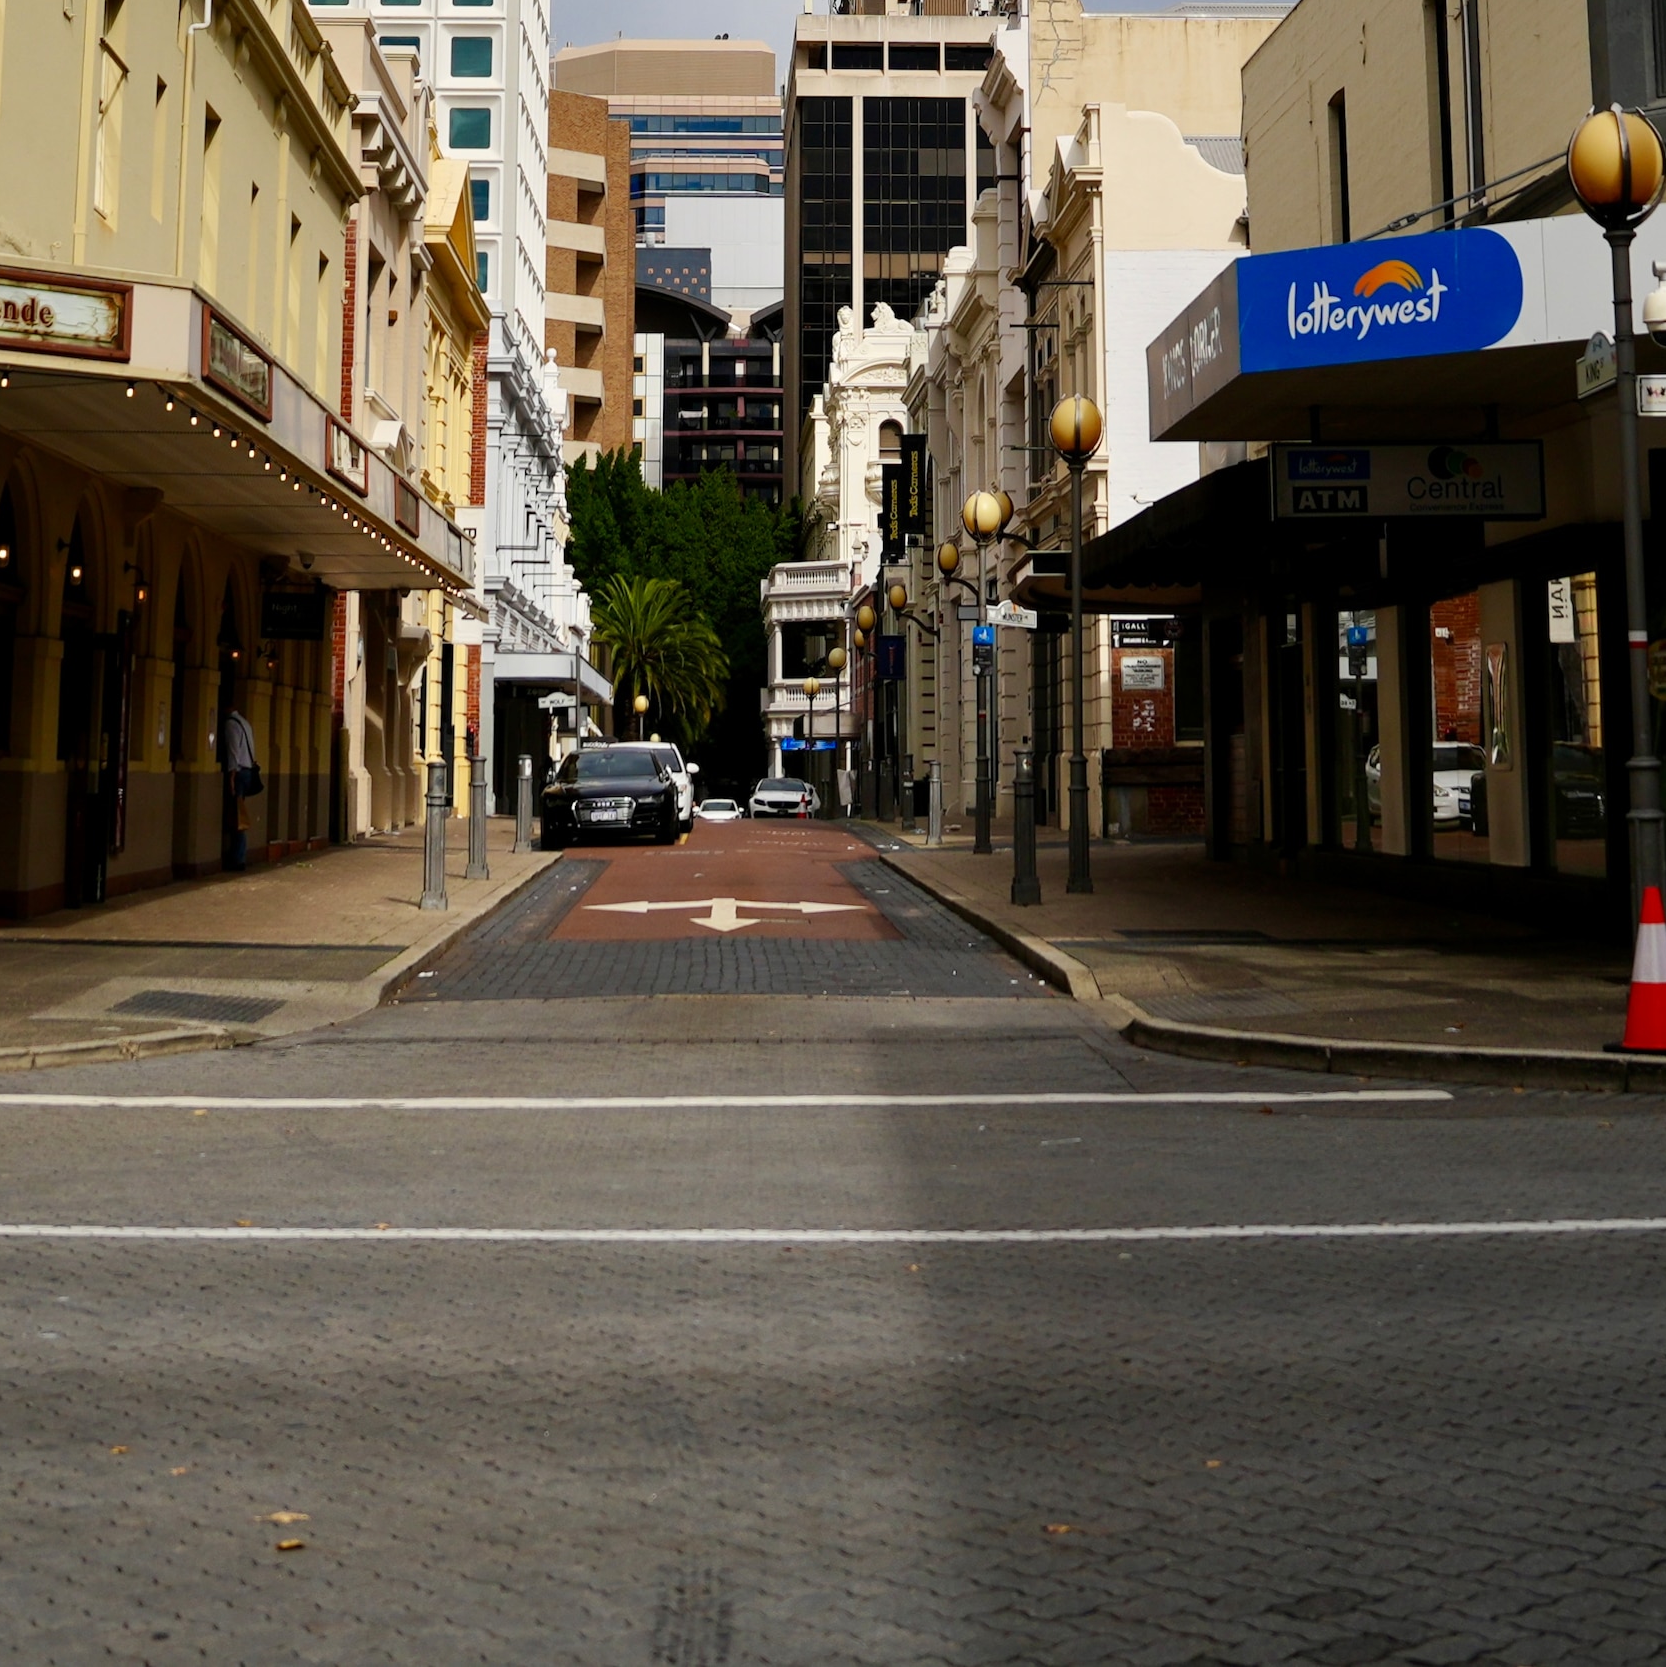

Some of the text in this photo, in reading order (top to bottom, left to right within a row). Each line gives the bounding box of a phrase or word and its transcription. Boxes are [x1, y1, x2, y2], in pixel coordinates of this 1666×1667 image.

[1287, 268, 1449, 340] lotterywest
[1586, 359, 1601, 386] KING
[1298, 456, 1358, 475] lotterywest
[1298, 489, 1361, 510] ATM
[1407, 475, 1505, 500] Central
